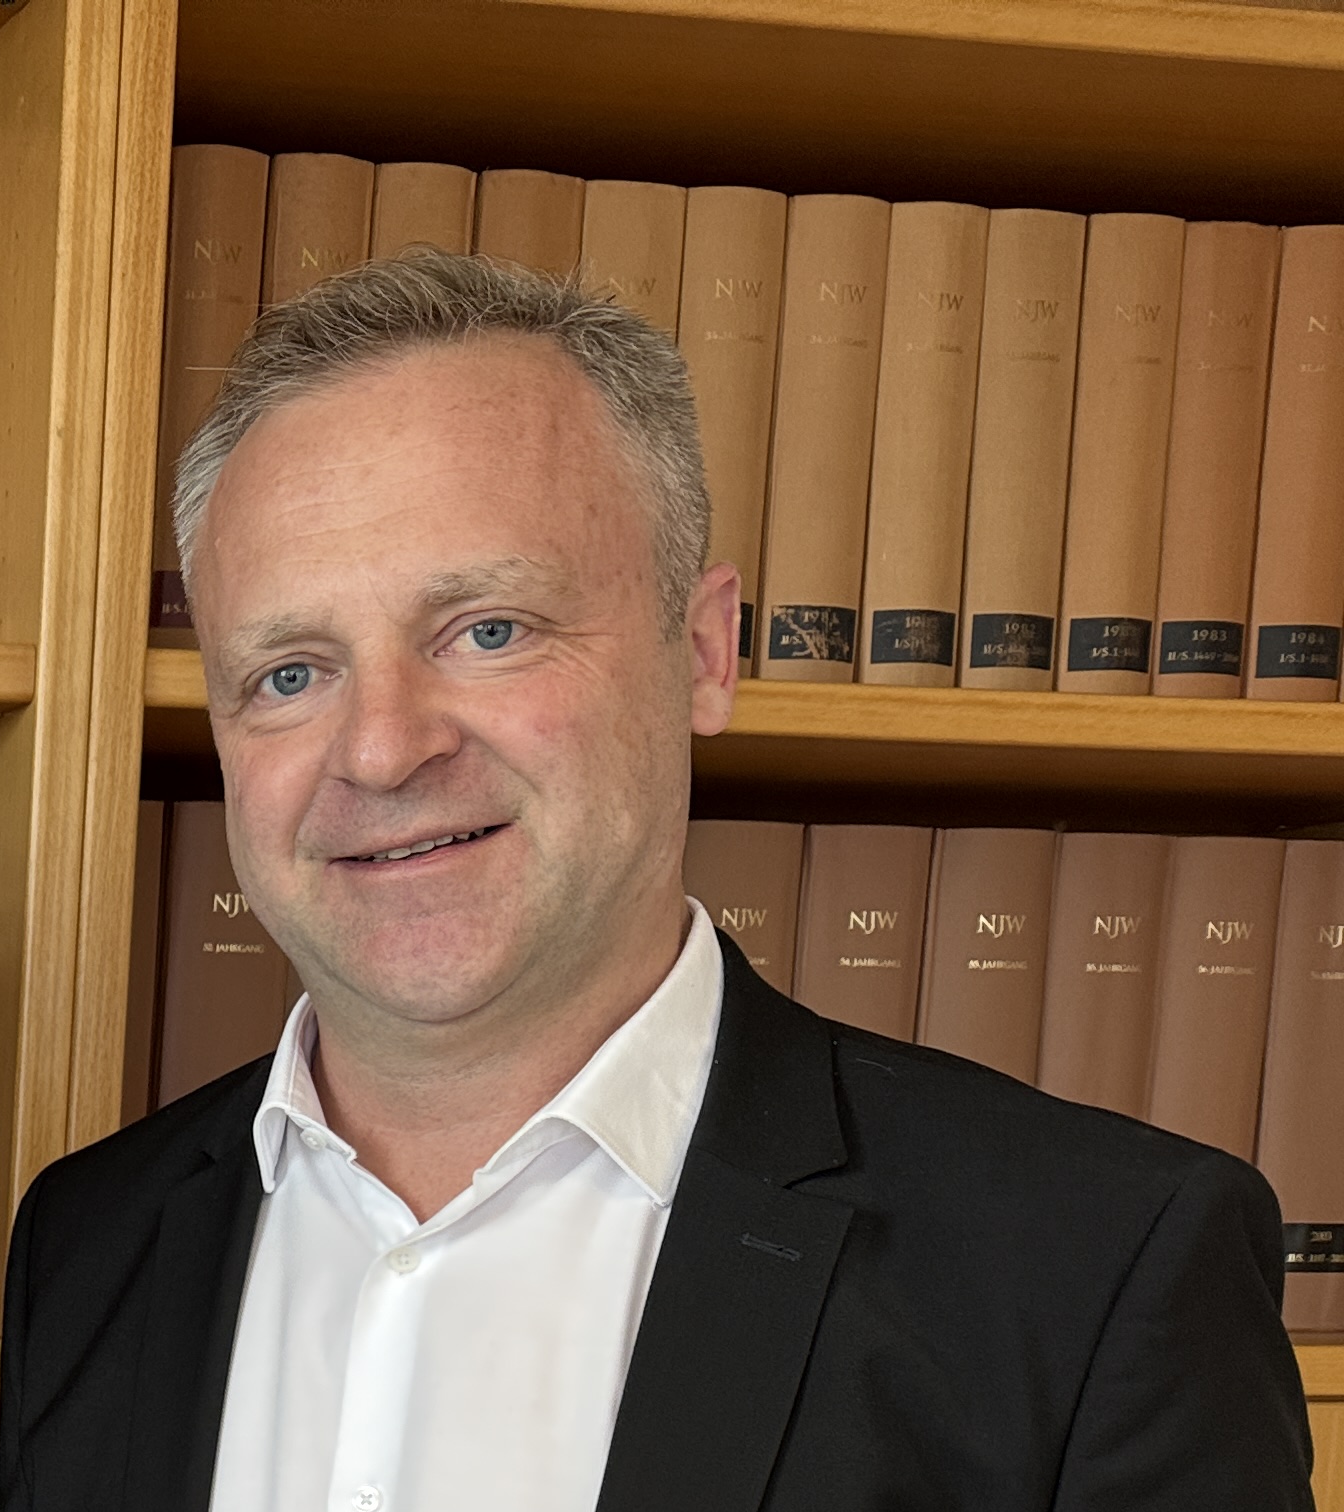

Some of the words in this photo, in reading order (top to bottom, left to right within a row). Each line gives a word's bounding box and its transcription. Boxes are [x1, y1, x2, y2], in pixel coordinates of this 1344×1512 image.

[1192, 629, 1227, 642] 1983
[721, 907, 767, 932] NJW
[848, 910, 899, 935] NJW
[976, 913, 1026, 938] NJW
[1093, 915, 1141, 939] NJW
[1206, 921, 1255, 945] NJW
[1319, 925, 1344, 949] NJ
